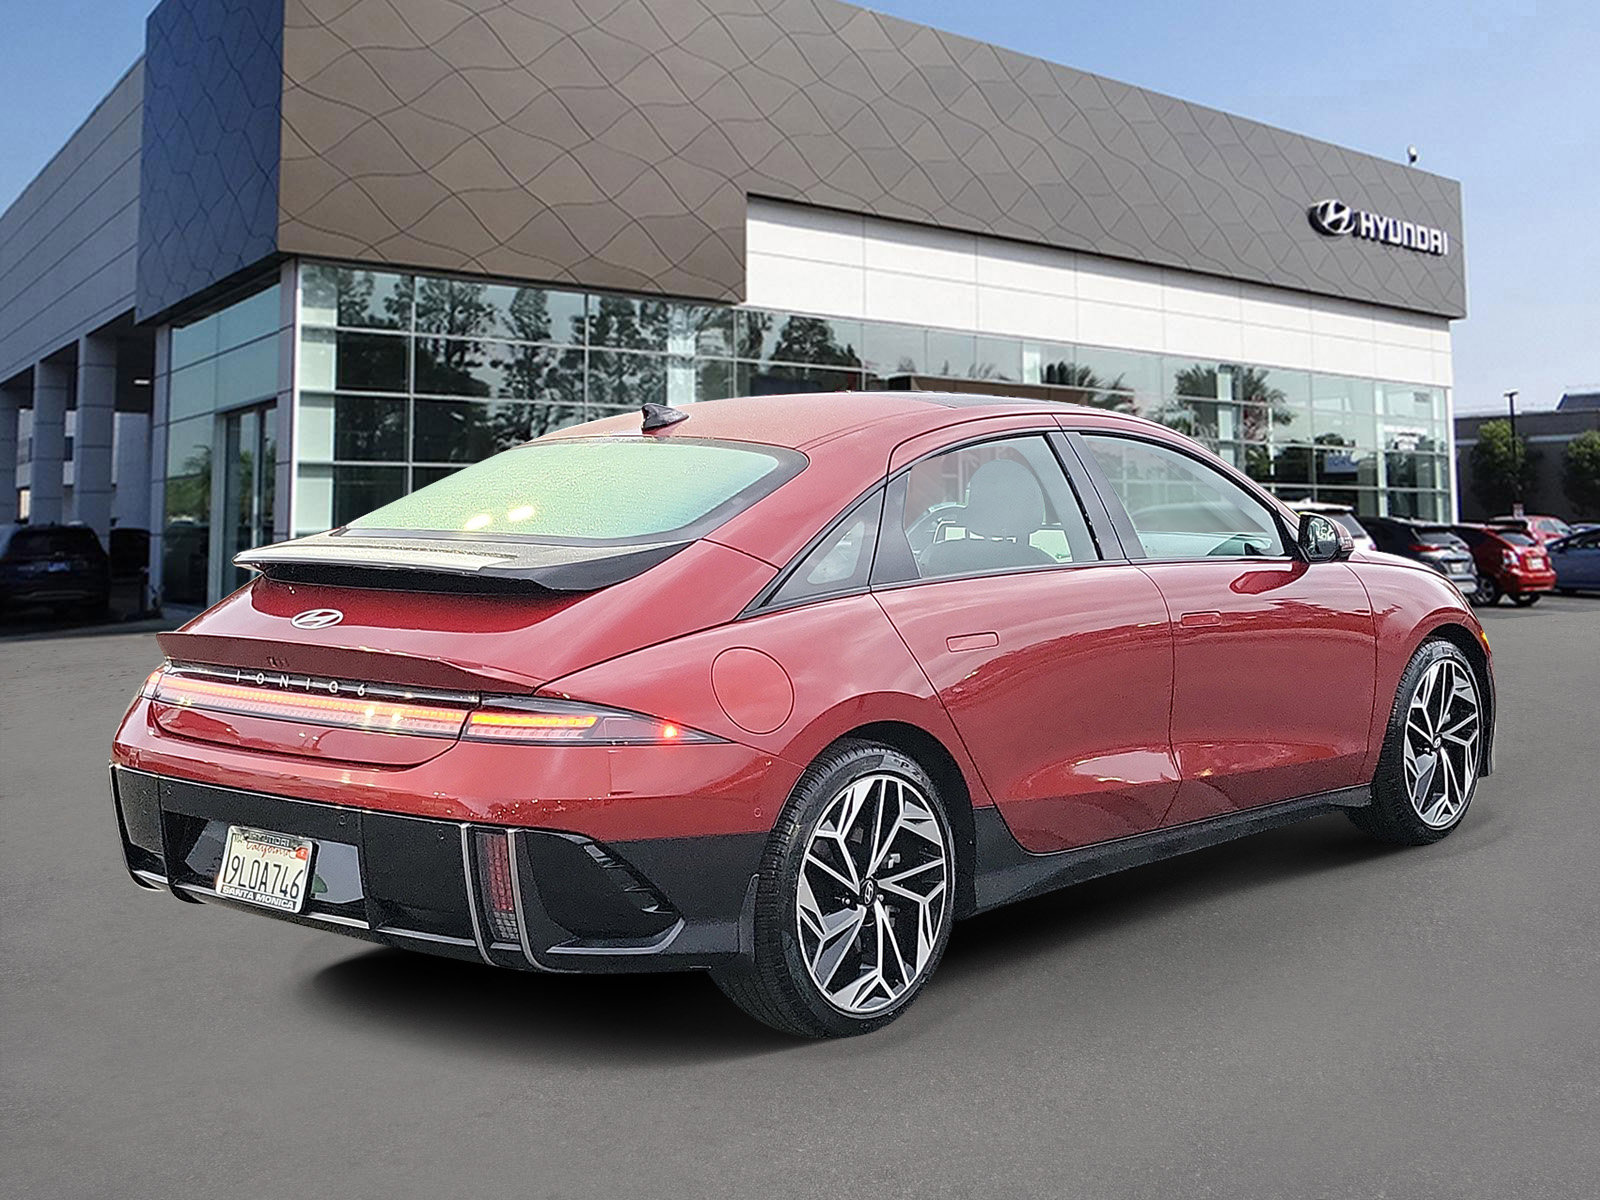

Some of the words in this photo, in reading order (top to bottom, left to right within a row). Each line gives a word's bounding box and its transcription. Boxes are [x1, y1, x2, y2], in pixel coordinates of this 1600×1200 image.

[1360, 210, 1448, 256] HYUNDAI
[235, 670, 339, 694] IONIQ
[357, 684, 366, 697] 6
[222, 886, 254, 900] SANTA
[255, 894, 294, 910] MONICA
